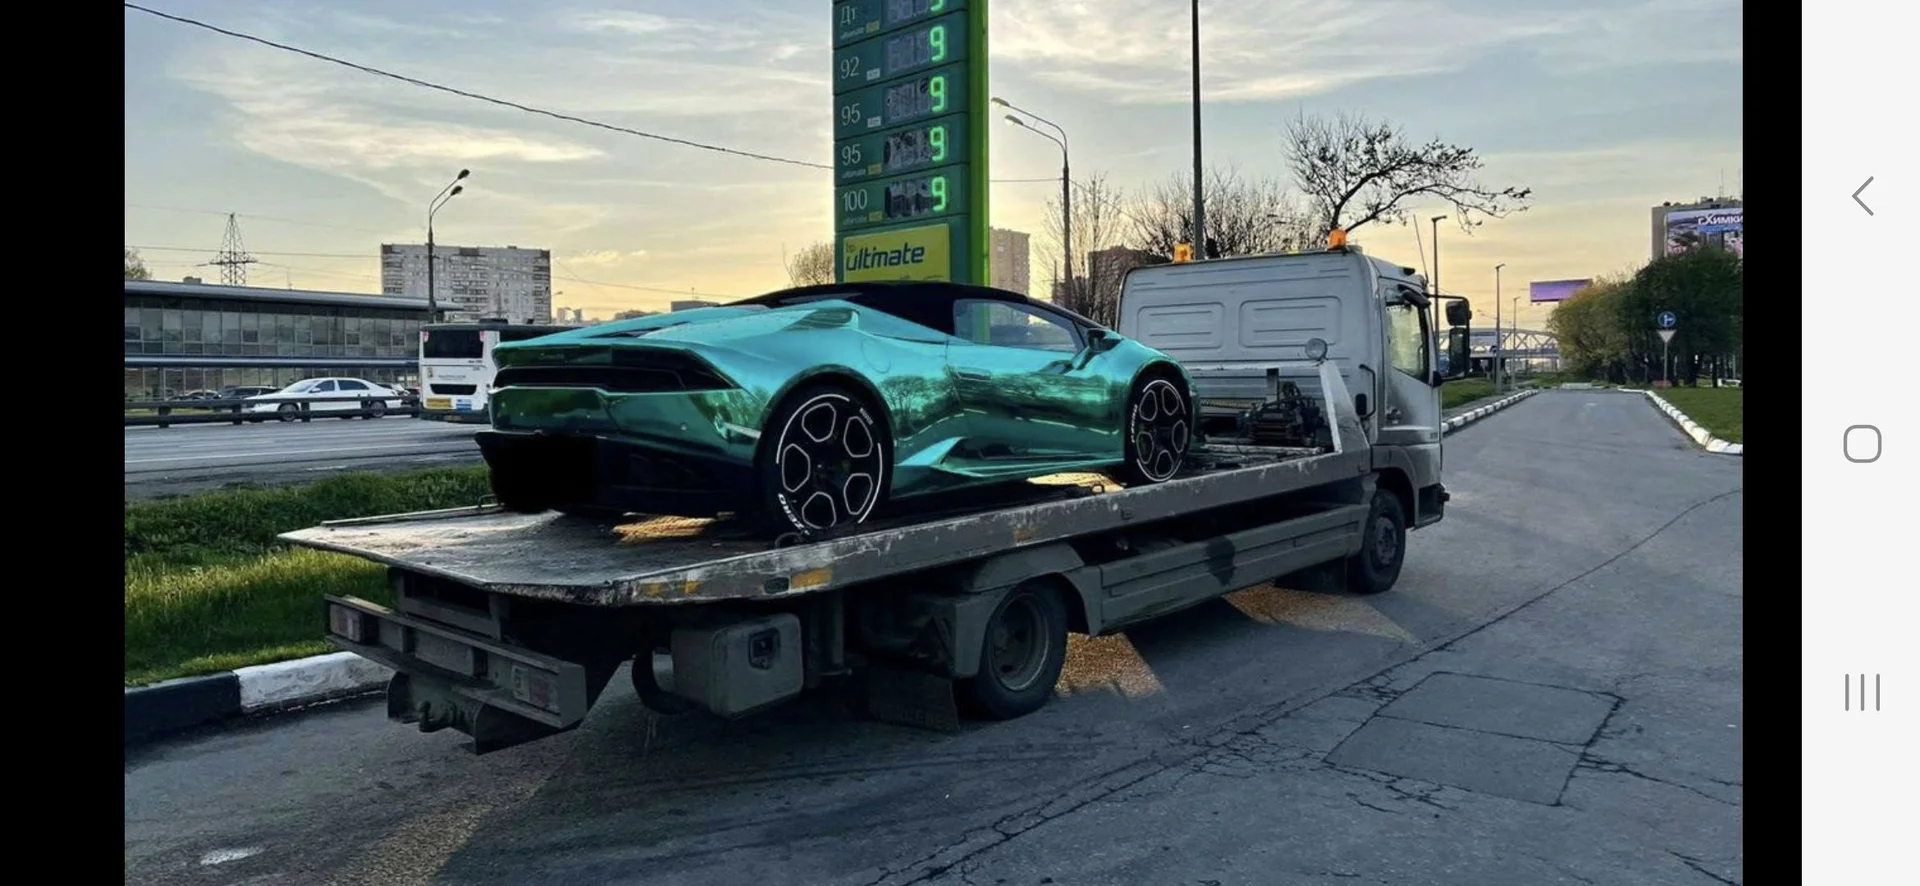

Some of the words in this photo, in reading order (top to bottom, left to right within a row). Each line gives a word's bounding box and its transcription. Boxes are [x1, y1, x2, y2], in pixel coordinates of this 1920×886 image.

[840, 6, 856, 26] Дт
[930, 25, 945, 61] 9
[840, 56, 860, 79] 92
[930, 76, 945, 112] 9
[841, 103, 861, 126] 95
[842, 144, 861, 166] 95
[930, 126, 945, 161] 9
[843, 189, 868, 212] 100
[931, 176, 946, 211] 9
[846, 242, 925, 272] ultimate
